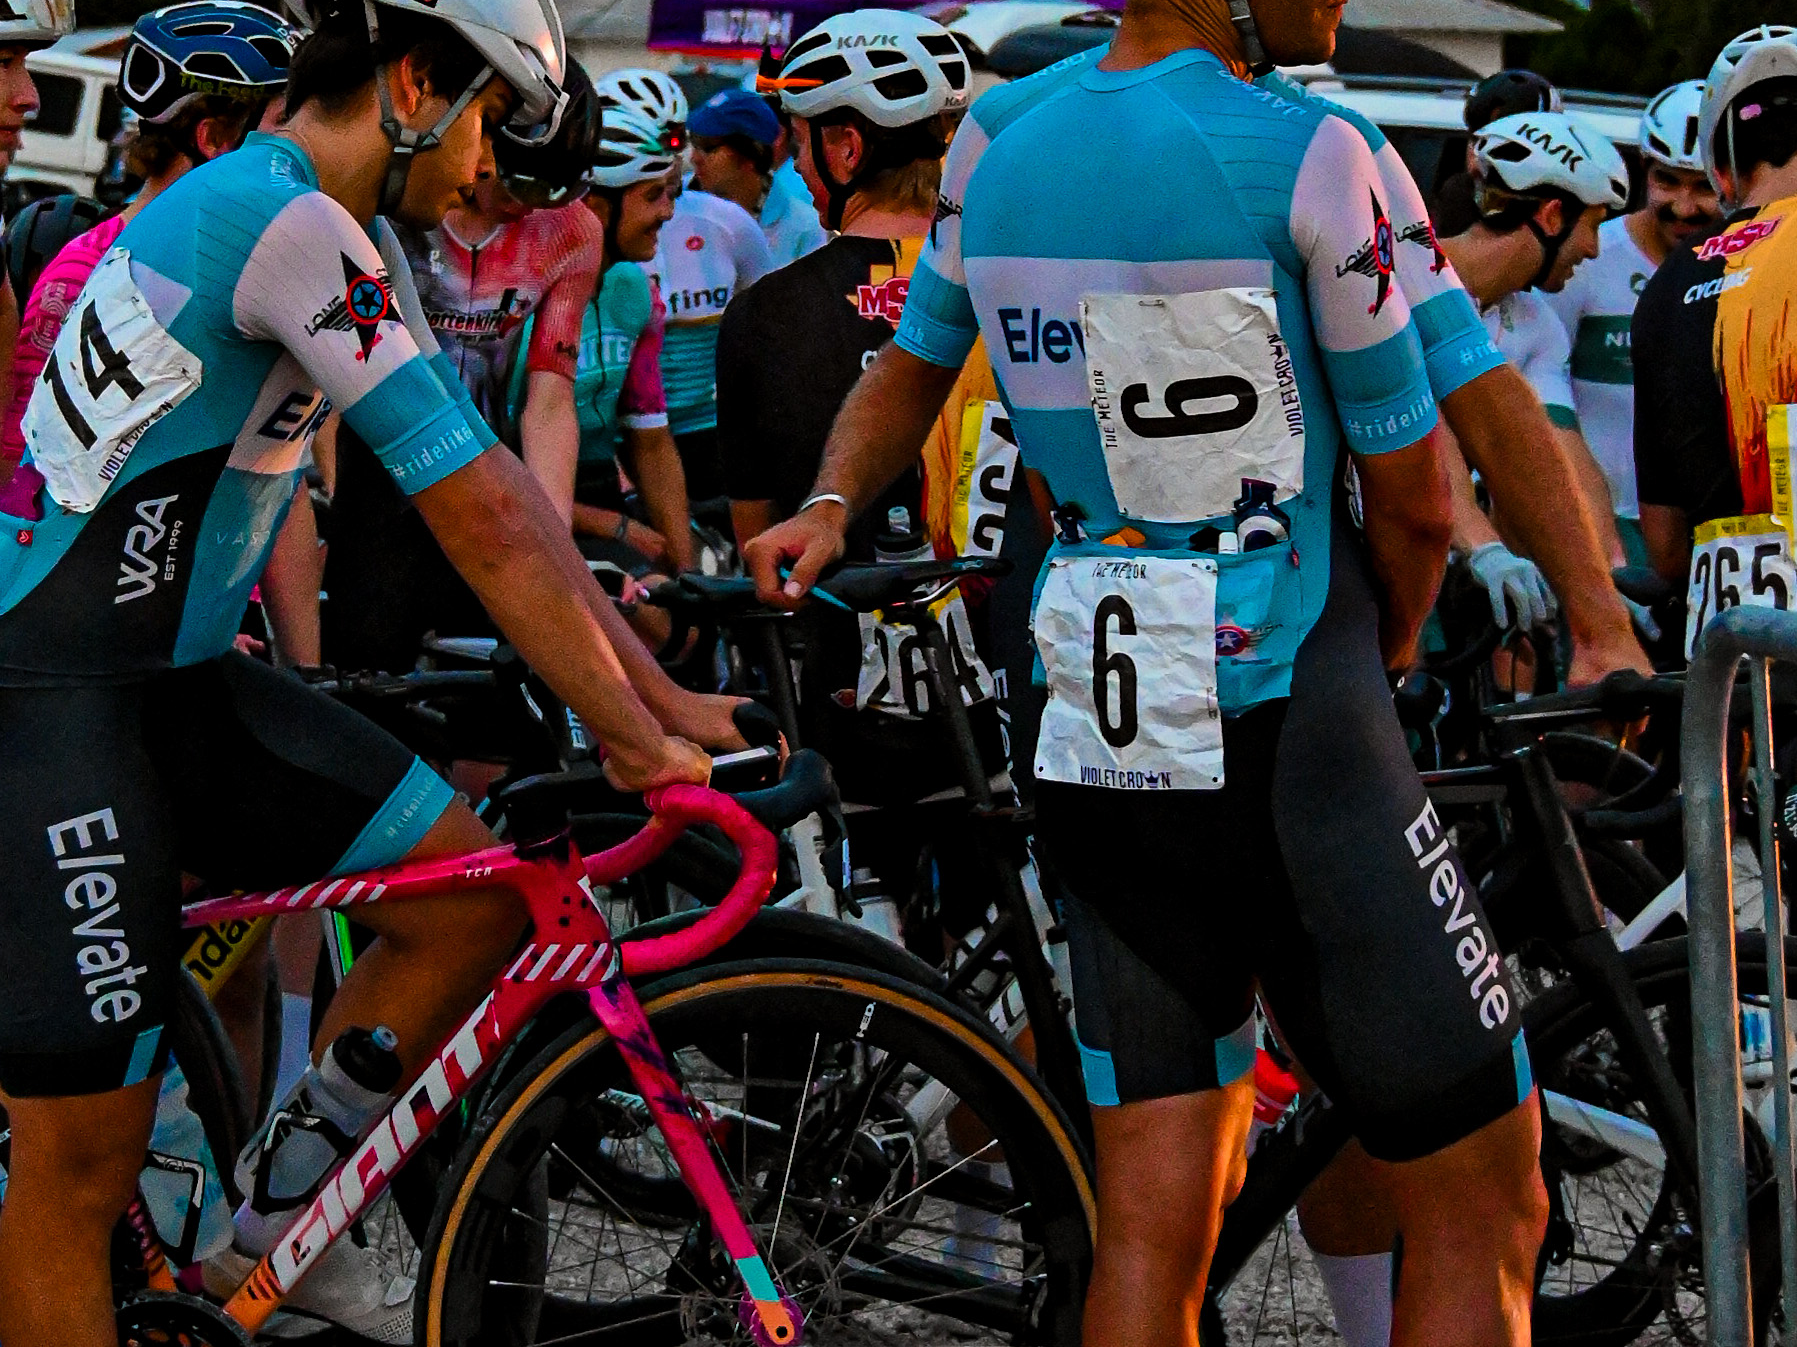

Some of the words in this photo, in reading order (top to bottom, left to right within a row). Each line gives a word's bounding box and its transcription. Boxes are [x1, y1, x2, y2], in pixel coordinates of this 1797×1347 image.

[837, 34, 900, 50] KASK
[1516, 123, 1584, 173] KASK
[43, 298, 146, 452] 14
[1093, 369, 1111, 420] METEOR
[1105, 426, 1118, 448] THE
[1280, 390, 1304, 438] VIOLET
[168, 519, 184, 551] 1999
[163, 555, 177, 582] EST
[1092, 593, 1138, 748] 6
[1080, 765, 1116, 787] VIOLET
[46, 806, 148, 1023] Elevate
[1403, 796, 1510, 1030] Elevate
[271, 989, 500, 1294] GIANT
